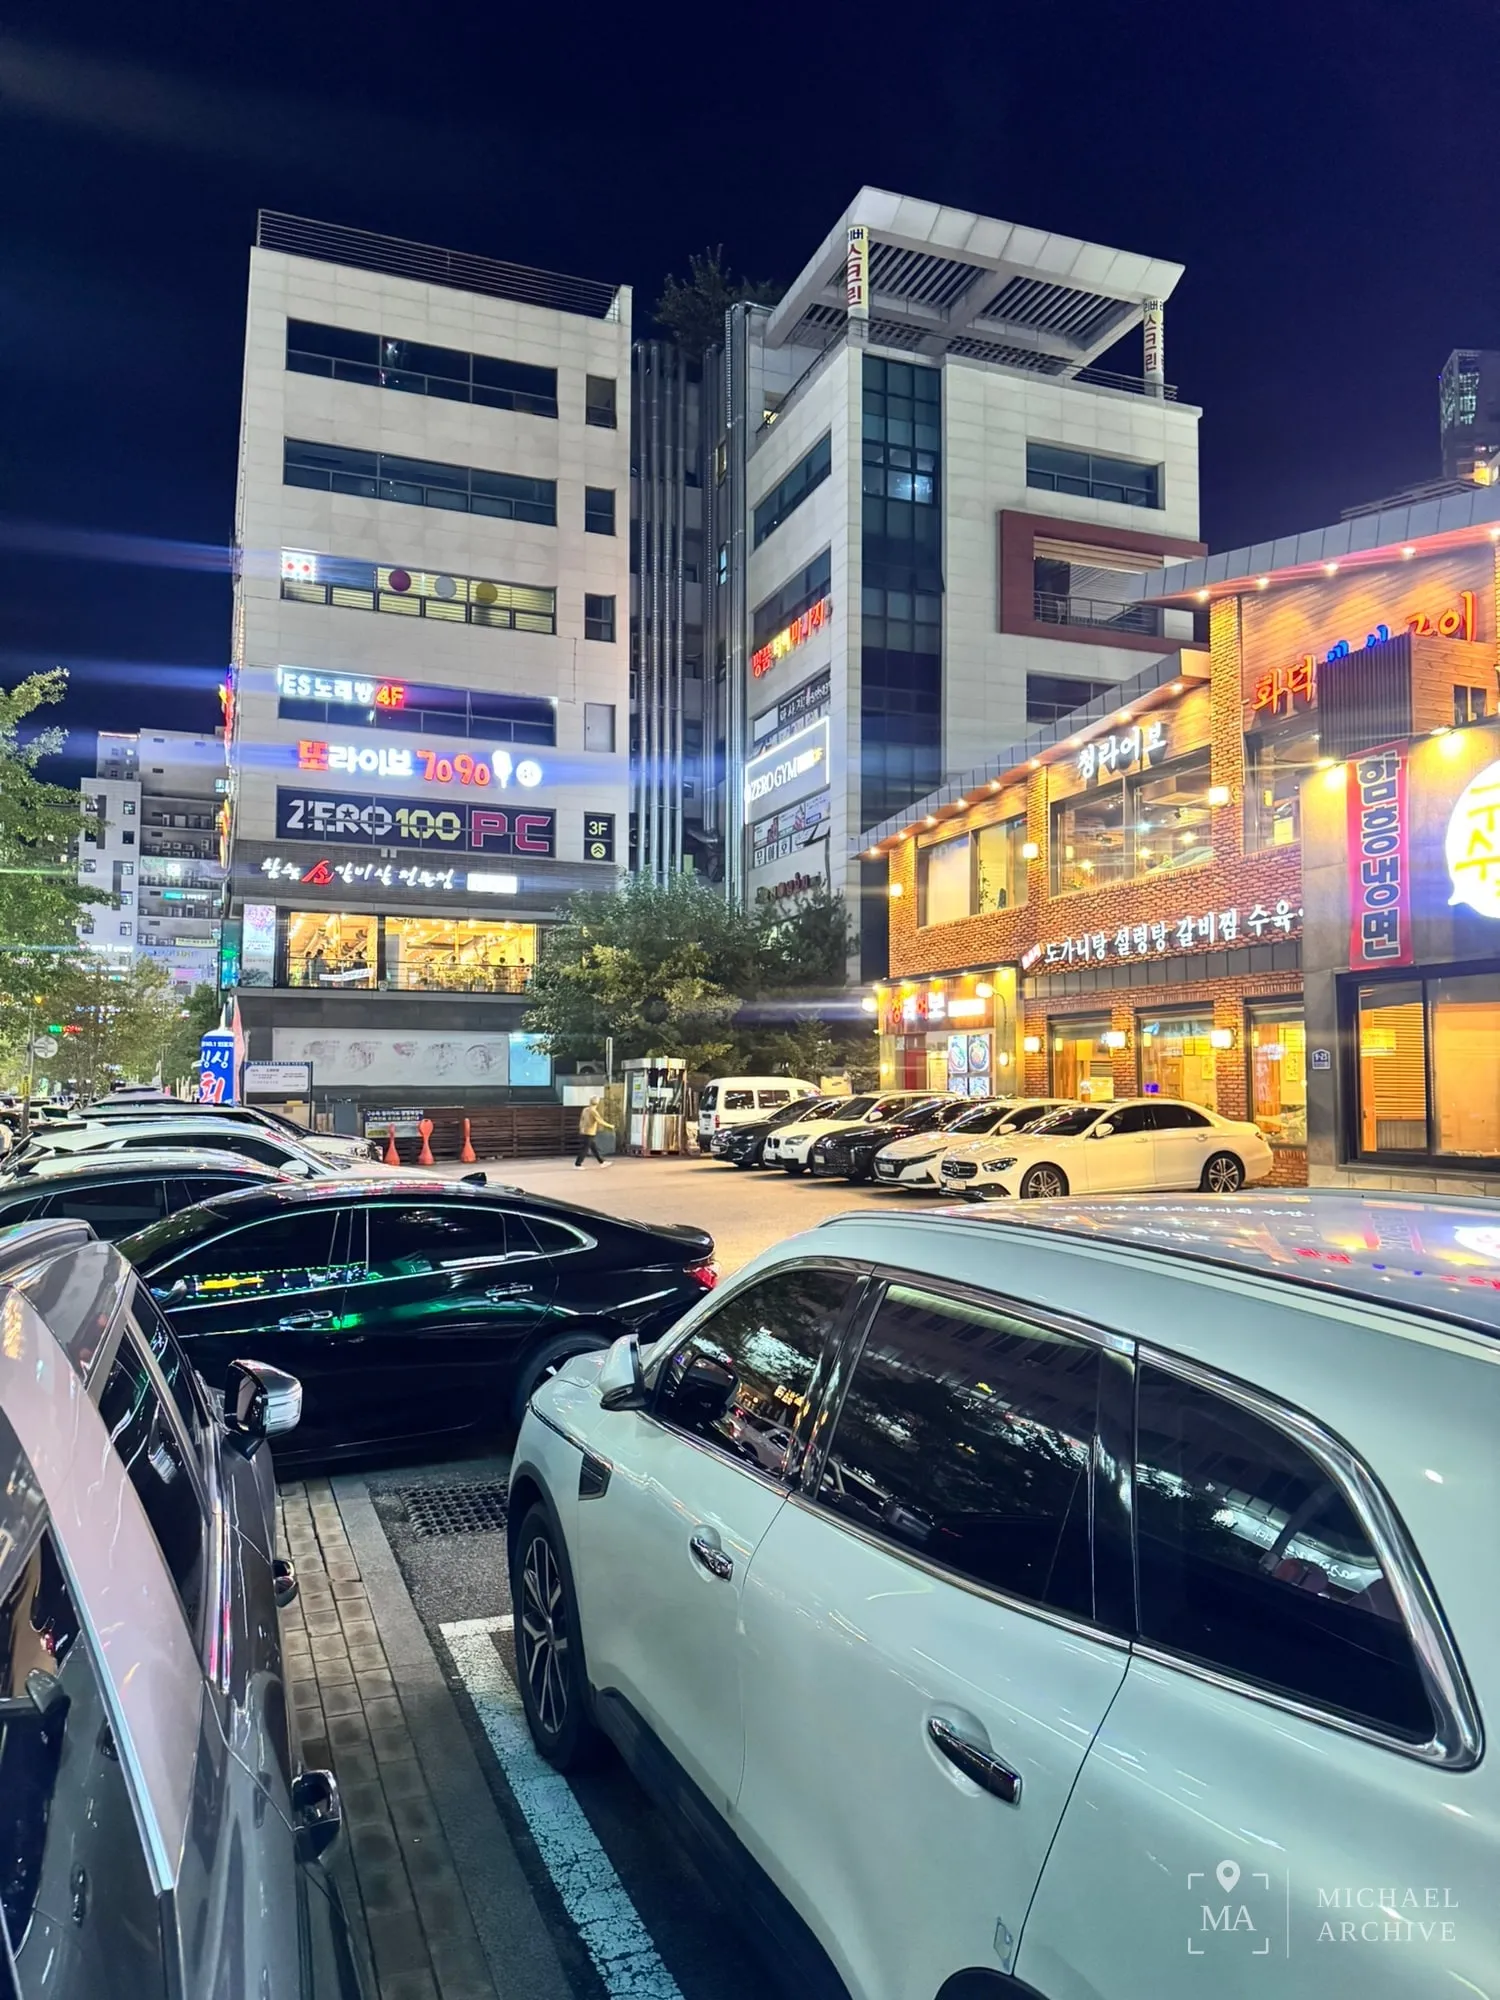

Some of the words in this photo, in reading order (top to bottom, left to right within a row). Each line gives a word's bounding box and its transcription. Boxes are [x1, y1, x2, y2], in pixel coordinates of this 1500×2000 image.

[314, 676, 374, 703] 노래방
[376, 684, 405, 706] 4F
[1251, 653, 1317, 715] 화덕
[416, 749, 491, 787] 7090
[1076, 721, 1168, 779] 청라어보
[750, 771, 773, 801] ZERO
[774, 756, 798, 788] GYM
[395, 807, 462, 841] 100
[470, 810, 552, 853] PC
[588, 820, 608, 835] 3F
[1356, 749, 1402, 960] 함흥냉면
[1043, 930, 1105, 965] 도가니탕
[1113, 920, 1168, 956] 설렁탕
[1175, 908, 1238, 949] 갈비찜
[1246, 899, 1296, 937] 수육
